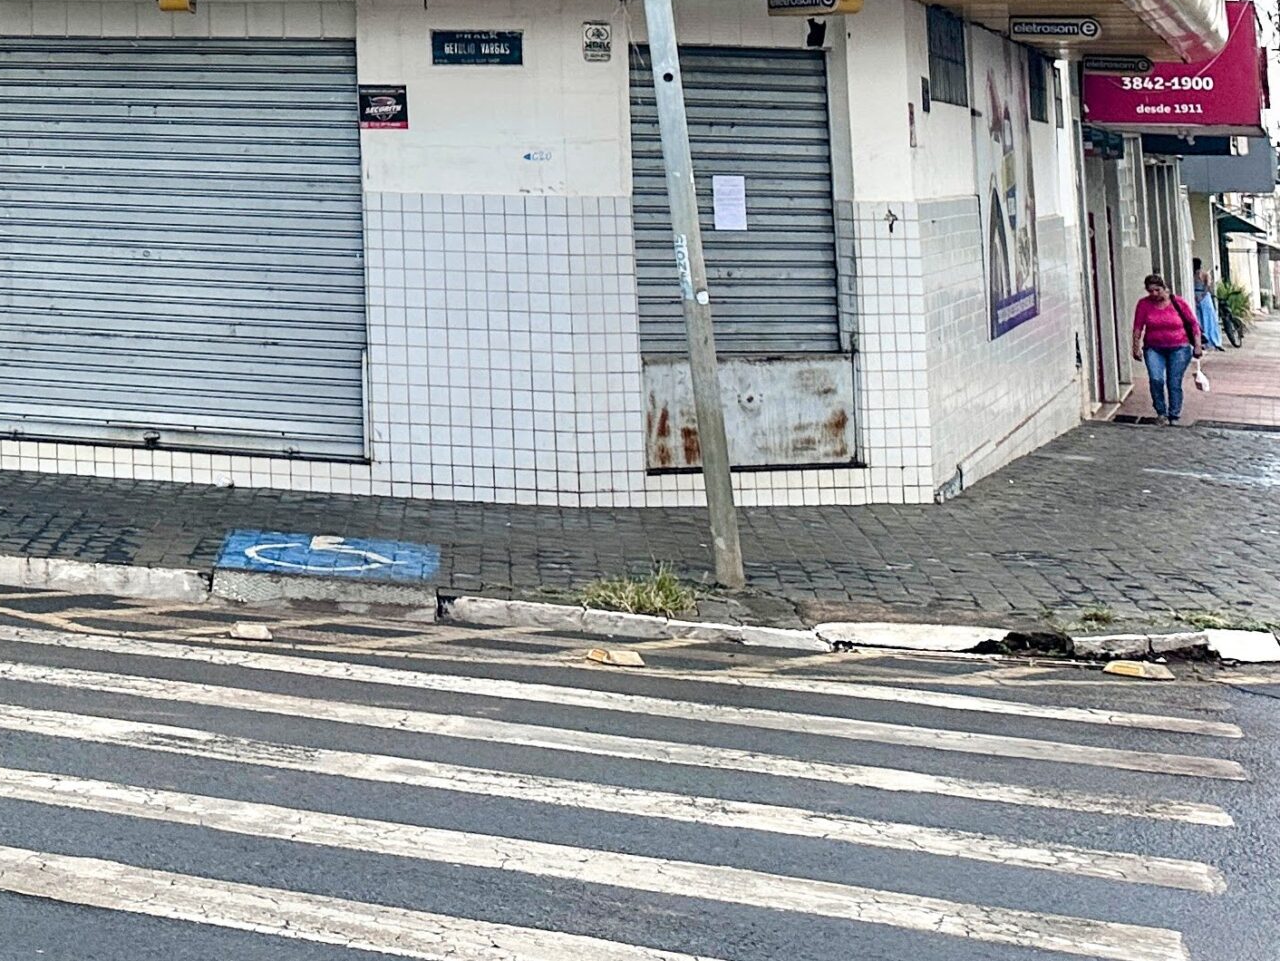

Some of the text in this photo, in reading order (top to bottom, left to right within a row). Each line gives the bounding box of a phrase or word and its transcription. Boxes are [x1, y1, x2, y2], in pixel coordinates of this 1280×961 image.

[1014, 23, 1095, 34] eletrosom e
[481, 43, 510, 54] VARGAS
[1121, 76, 1214, 90] 3842-1900
[1136, 103, 1203, 114] desde 1911
